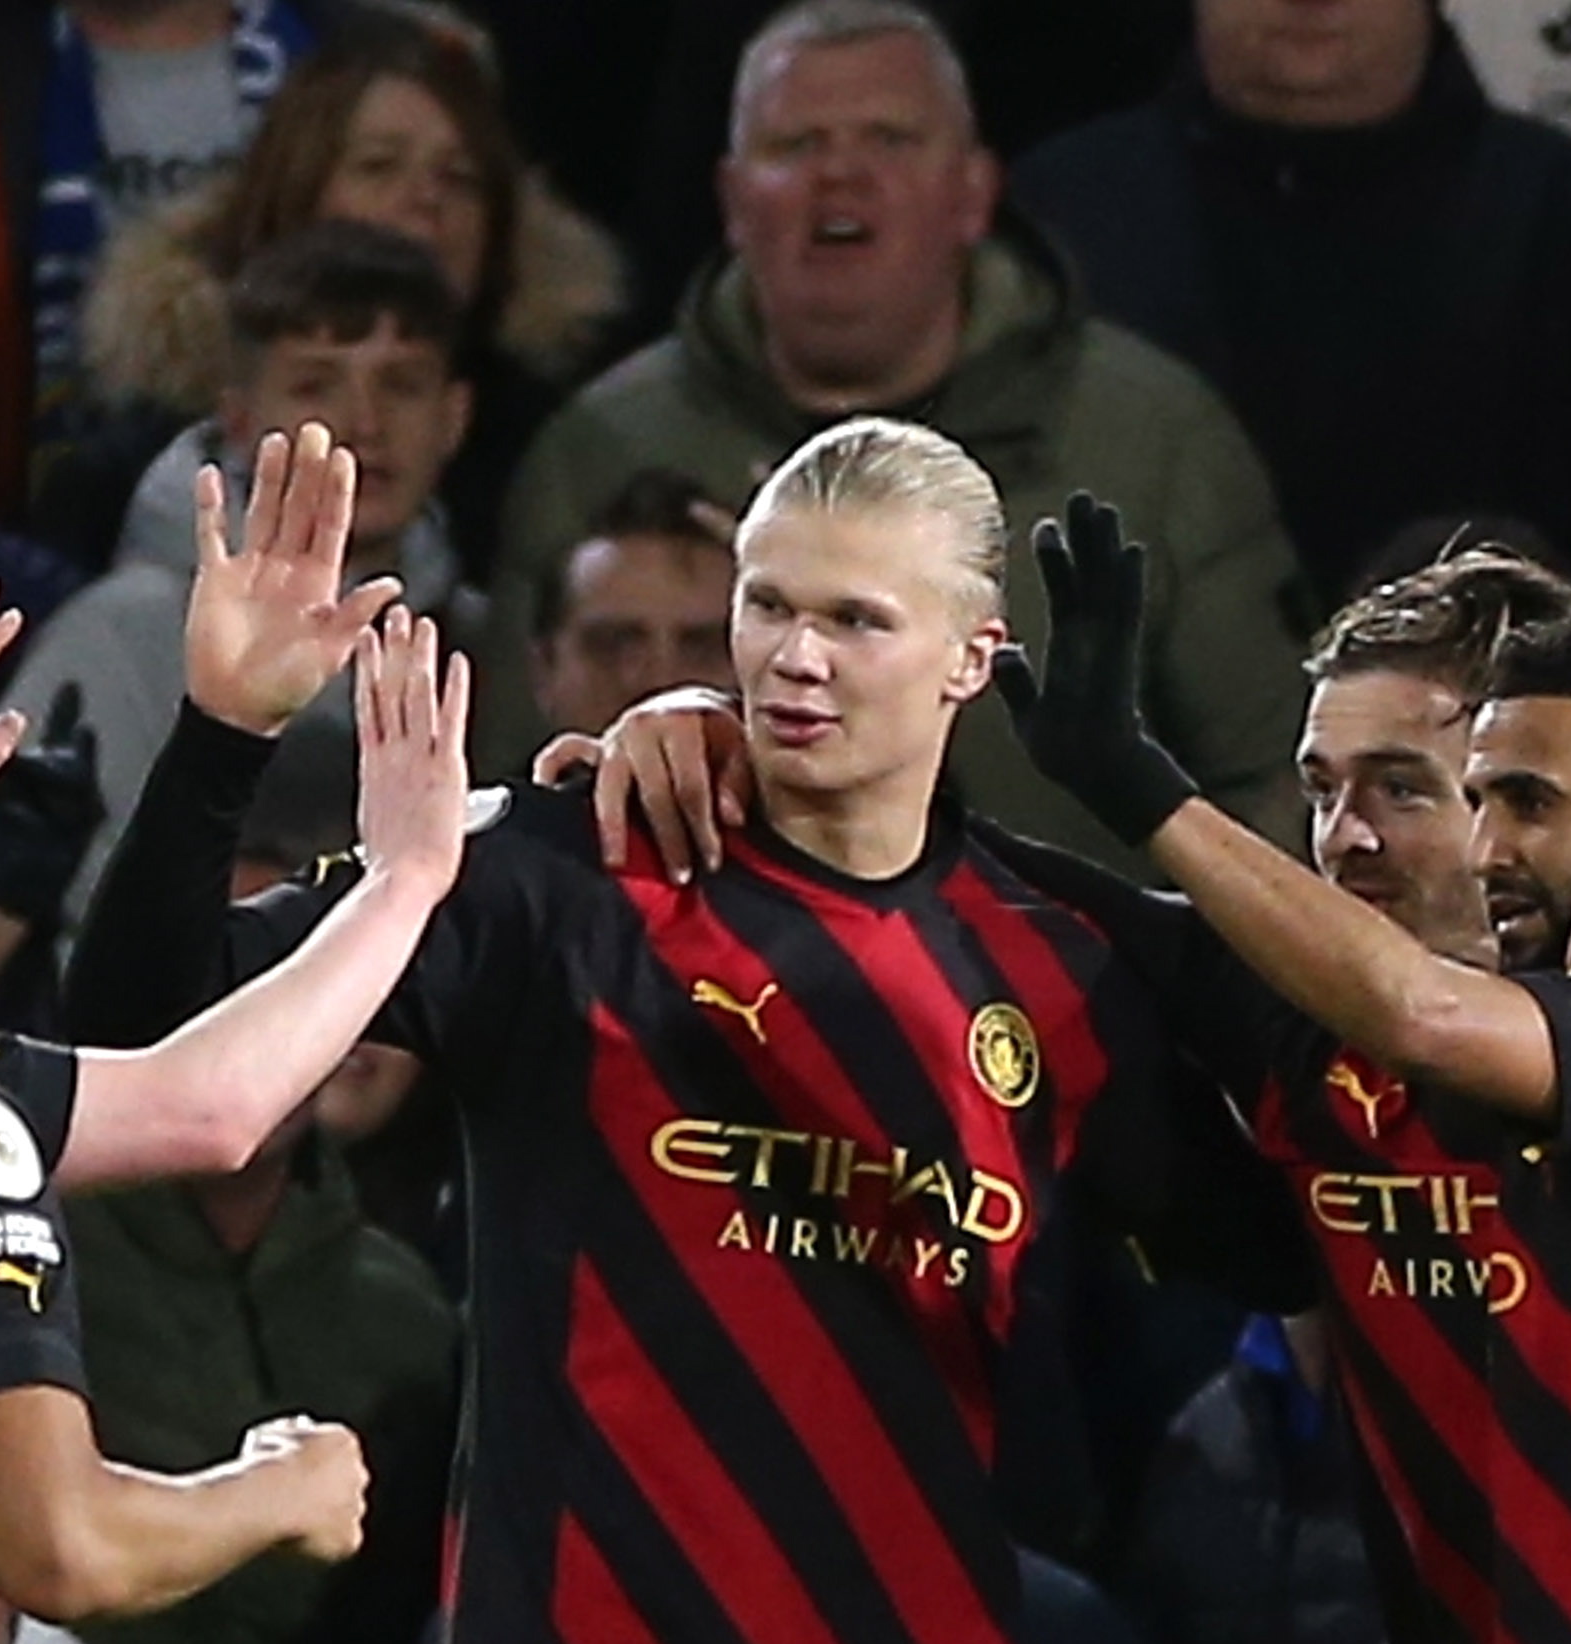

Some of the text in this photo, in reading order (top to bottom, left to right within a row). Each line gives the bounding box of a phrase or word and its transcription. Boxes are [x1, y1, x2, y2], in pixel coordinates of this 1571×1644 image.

[650, 1118, 1024, 1243] ETIHAD
[1310, 1172, 1499, 1234] ETIH
[717, 1210, 971, 1287] AIRWAYS
